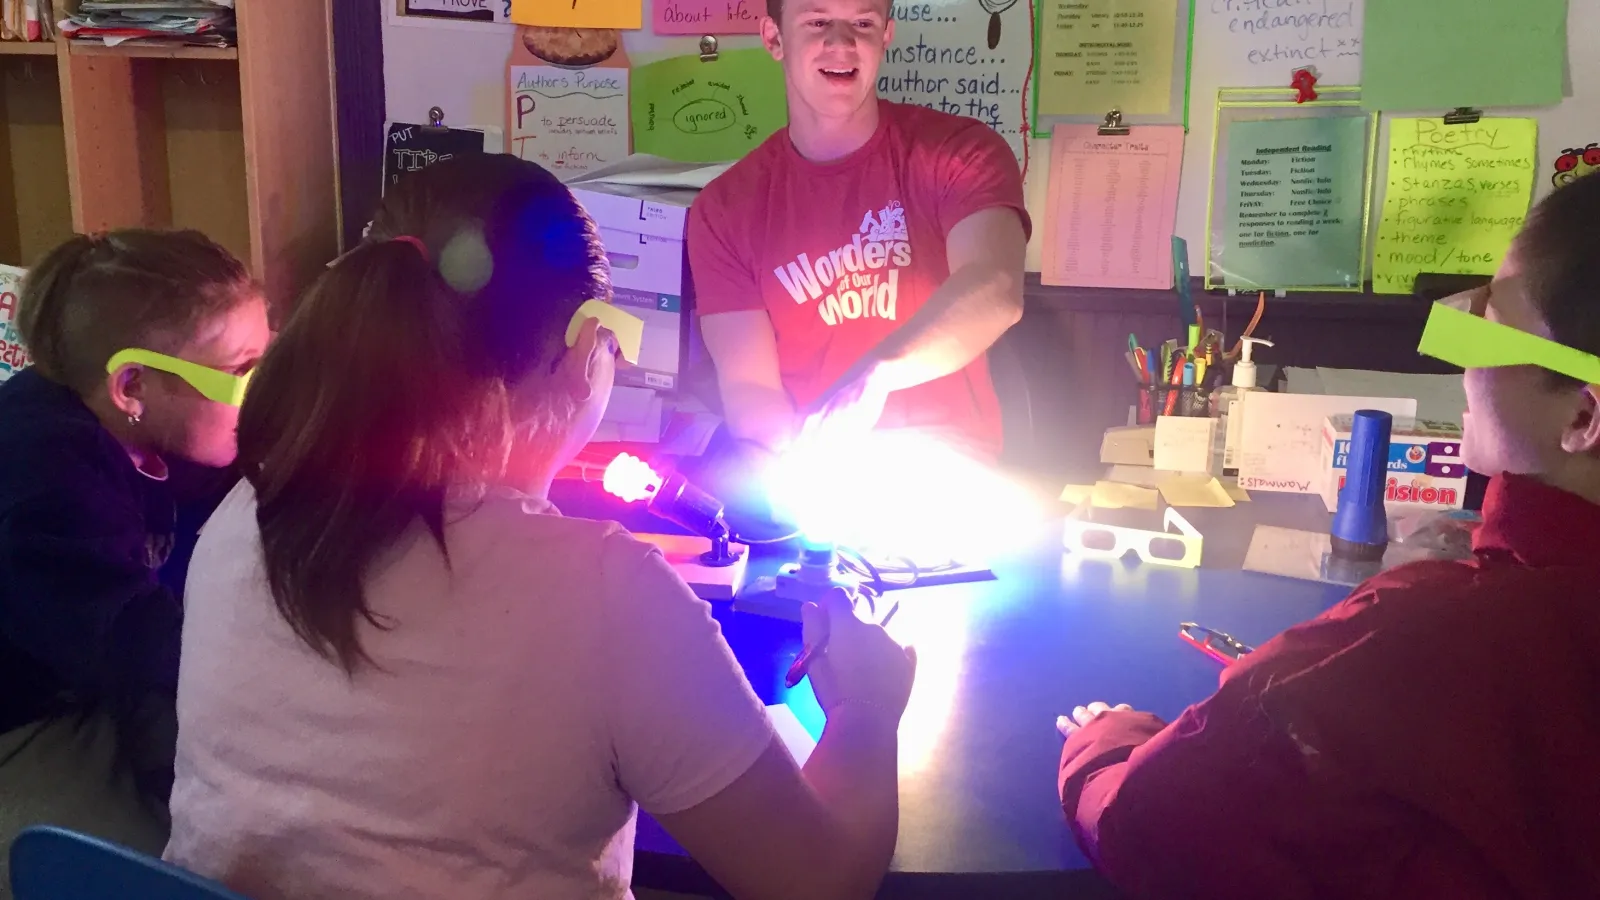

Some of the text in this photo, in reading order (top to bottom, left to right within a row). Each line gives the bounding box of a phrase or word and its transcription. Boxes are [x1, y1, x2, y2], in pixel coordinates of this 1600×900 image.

[663, 4, 712, 23] about
[1228, 4, 1353, 41] endangered
[885, 33, 1005, 65] instance...
[1247, 38, 1333, 64] extinct
[575, 71, 620, 90] Purpose
[878, 70, 1020, 95] author said...
[516, 95, 536, 129] P
[939, 96, 960, 115] to
[965, 98, 1000, 118] the
[541, 114, 617, 127] to persuade
[686, 107, 727, 132] ignored
[389, 127, 412, 143] PUT
[1415, 119, 1498, 146] Poetry
[557, 147, 606, 163] inform
[1256, 144, 1332, 155] Independent Reading
[393, 149, 453, 171] TIP
[1403, 158, 1455, 172] rhymes
[1480, 178, 1520, 191] verses
[1399, 196, 1468, 210] phrases
[1396, 210, 1524, 231] figurative language
[1392, 233, 1448, 245] theme
[773, 233, 912, 305] Wonders
[839, 274, 850, 291] of
[661, 297, 668, 307] 2
[1387, 458, 1408, 469] rds
